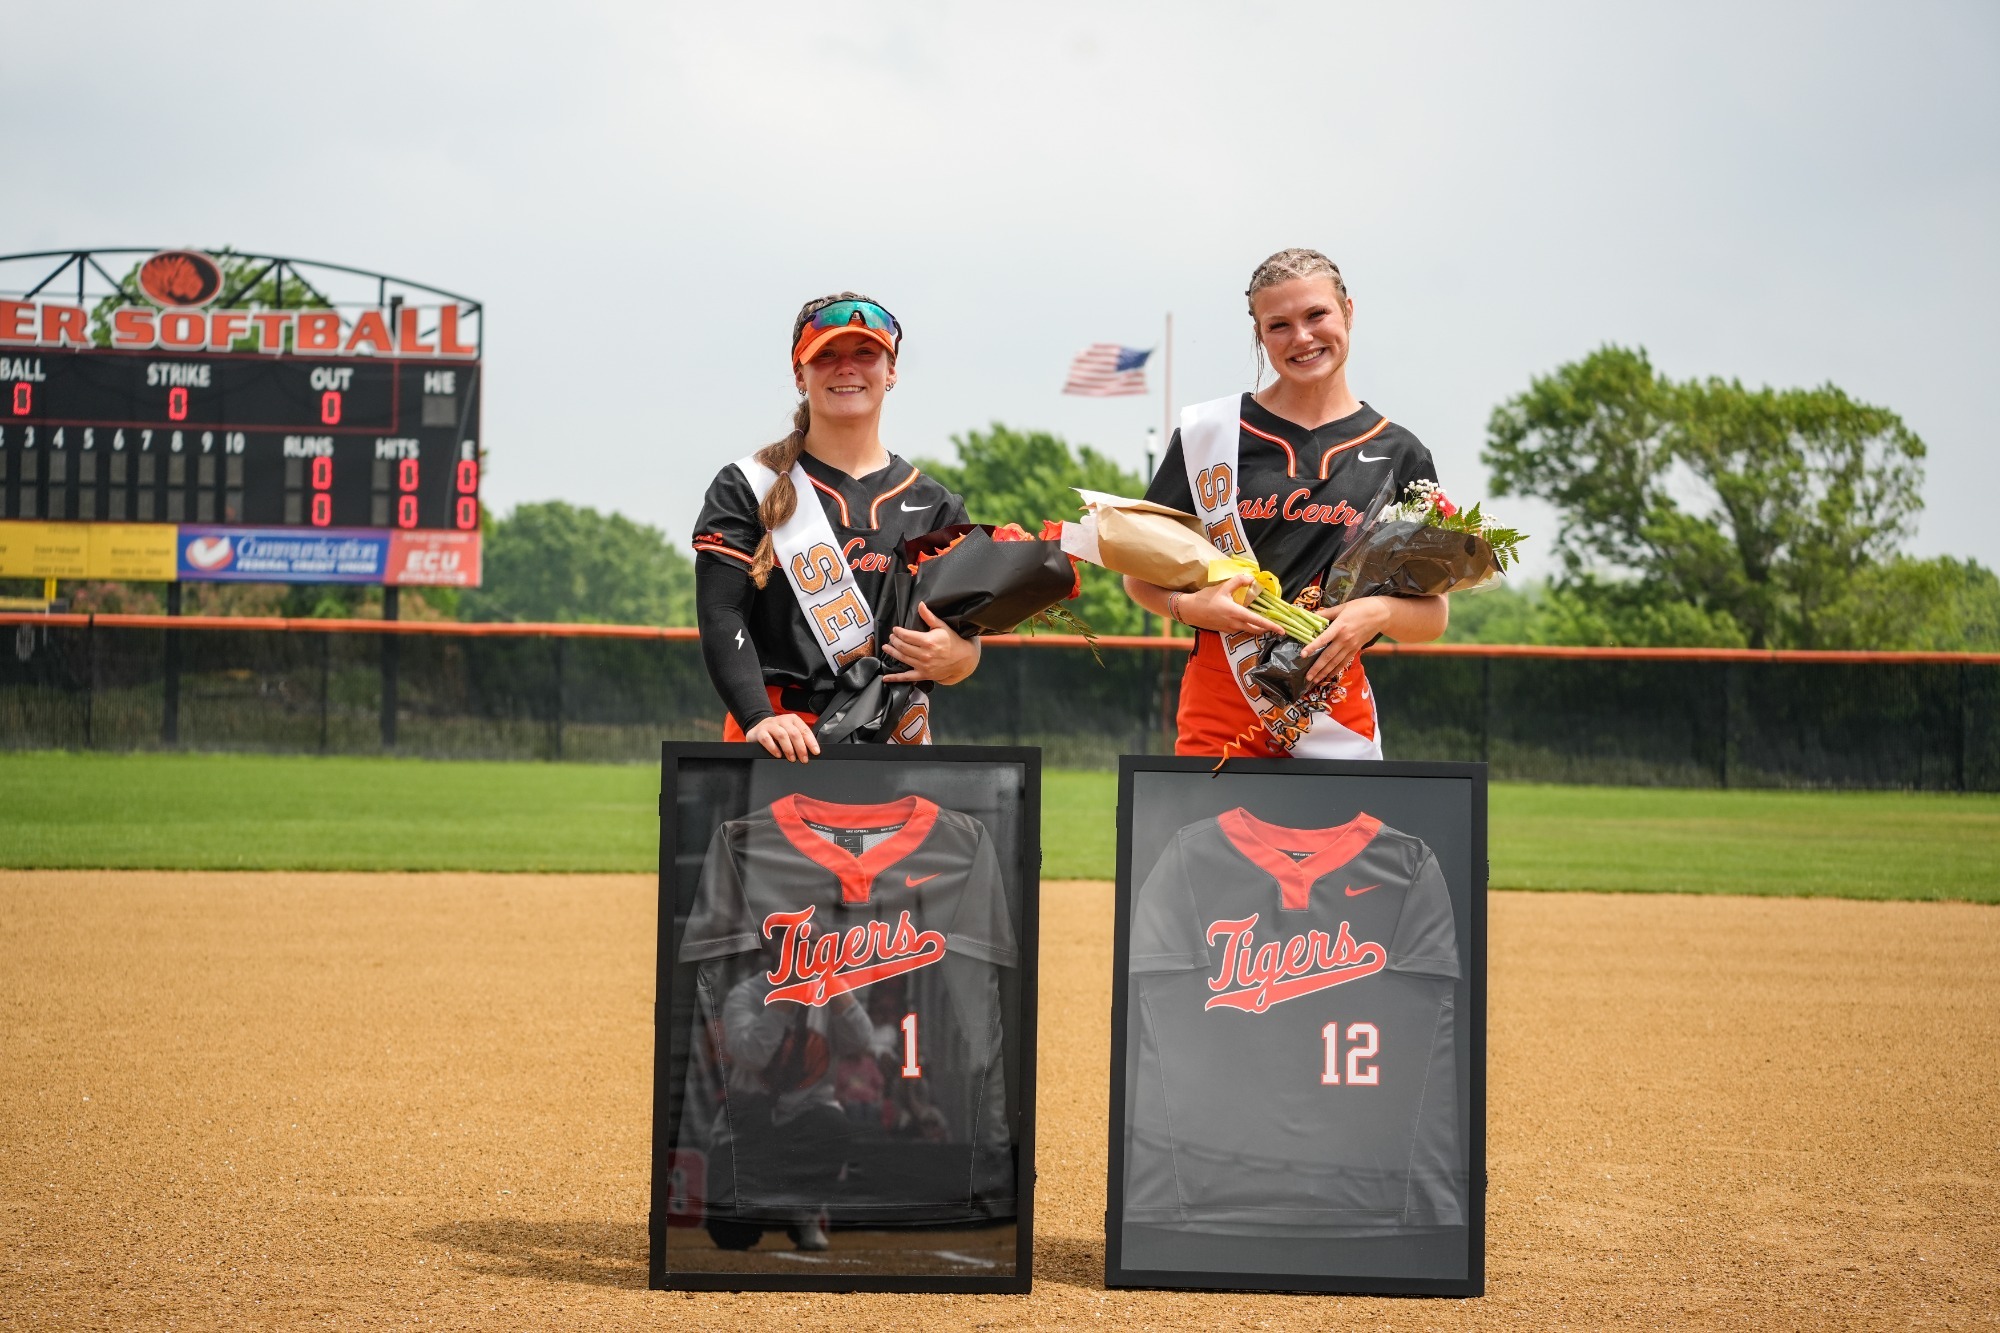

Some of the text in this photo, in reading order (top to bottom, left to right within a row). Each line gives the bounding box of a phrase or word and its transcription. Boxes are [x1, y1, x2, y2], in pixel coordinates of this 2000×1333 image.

[112, 304, 479, 359] SOFTBALL
[0, 357, 47, 382] BALL
[147, 362, 211, 387] STRIKE
[310, 367, 353, 391] OUT
[13, 382, 32, 415] 0
[168, 387, 188, 421] 0
[321, 391, 342, 425] 0
[24, 425, 35, 448] 3
[53, 427, 64, 449] 4
[83, 427, 94, 449] 5
[113, 428, 124, 451] 6
[141, 429, 153, 451] 7
[171, 430, 183, 453] 8
[201, 431, 213, 453] 9
[226, 432, 245, 454] 10
[284, 436, 475, 460] RUNS HITS E
[312, 456, 477, 494] 0 0 0
[311, 493, 476, 530] 0 0 0
[1236, 487, 1279, 519] ast
[237, 536, 379, 561] Communication
[406, 550, 460, 571] ECU
[842, 537, 892, 572] Cen
[762, 904, 947, 1007] Tigers
[1205, 912, 1388, 1014] Tigers
[901, 1012, 922, 1078] 1
[1321, 1021, 1380, 1086] 12
